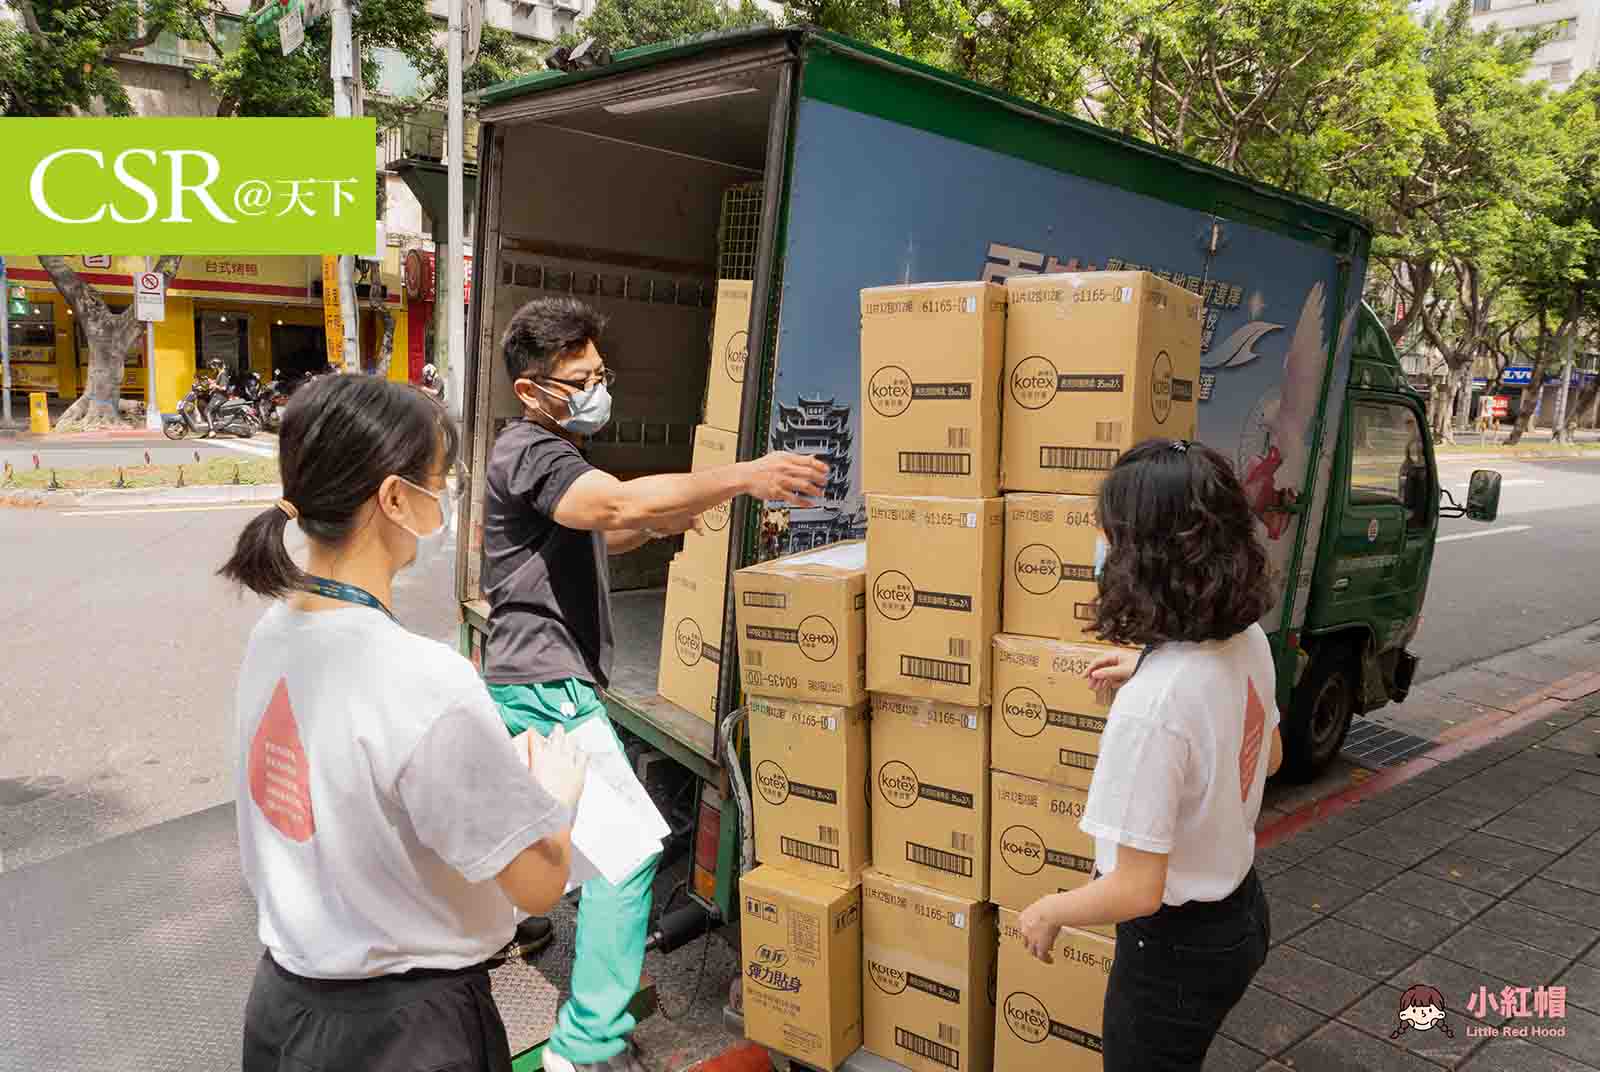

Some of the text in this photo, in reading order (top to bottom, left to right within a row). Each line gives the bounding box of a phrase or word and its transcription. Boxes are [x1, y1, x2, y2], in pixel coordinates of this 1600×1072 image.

[872, 382, 910, 398] kotex
[1014, 373, 1054, 390] kotex
[1018, 560, 1056, 576] kotex
[876, 583, 912, 601] kotex
[678, 629, 700, 650] kotex
[801, 632, 834, 645] kotex
[1005, 703, 1042, 721] kotex
[758, 772, 787, 791] kotex
[882, 773, 916, 793] kotex
[1003, 840, 1041, 860] kotex
[748, 961, 803, 992] 彈力貼身
[871, 959, 905, 982] kotex
[1007, 1000, 1048, 1031] kotex
